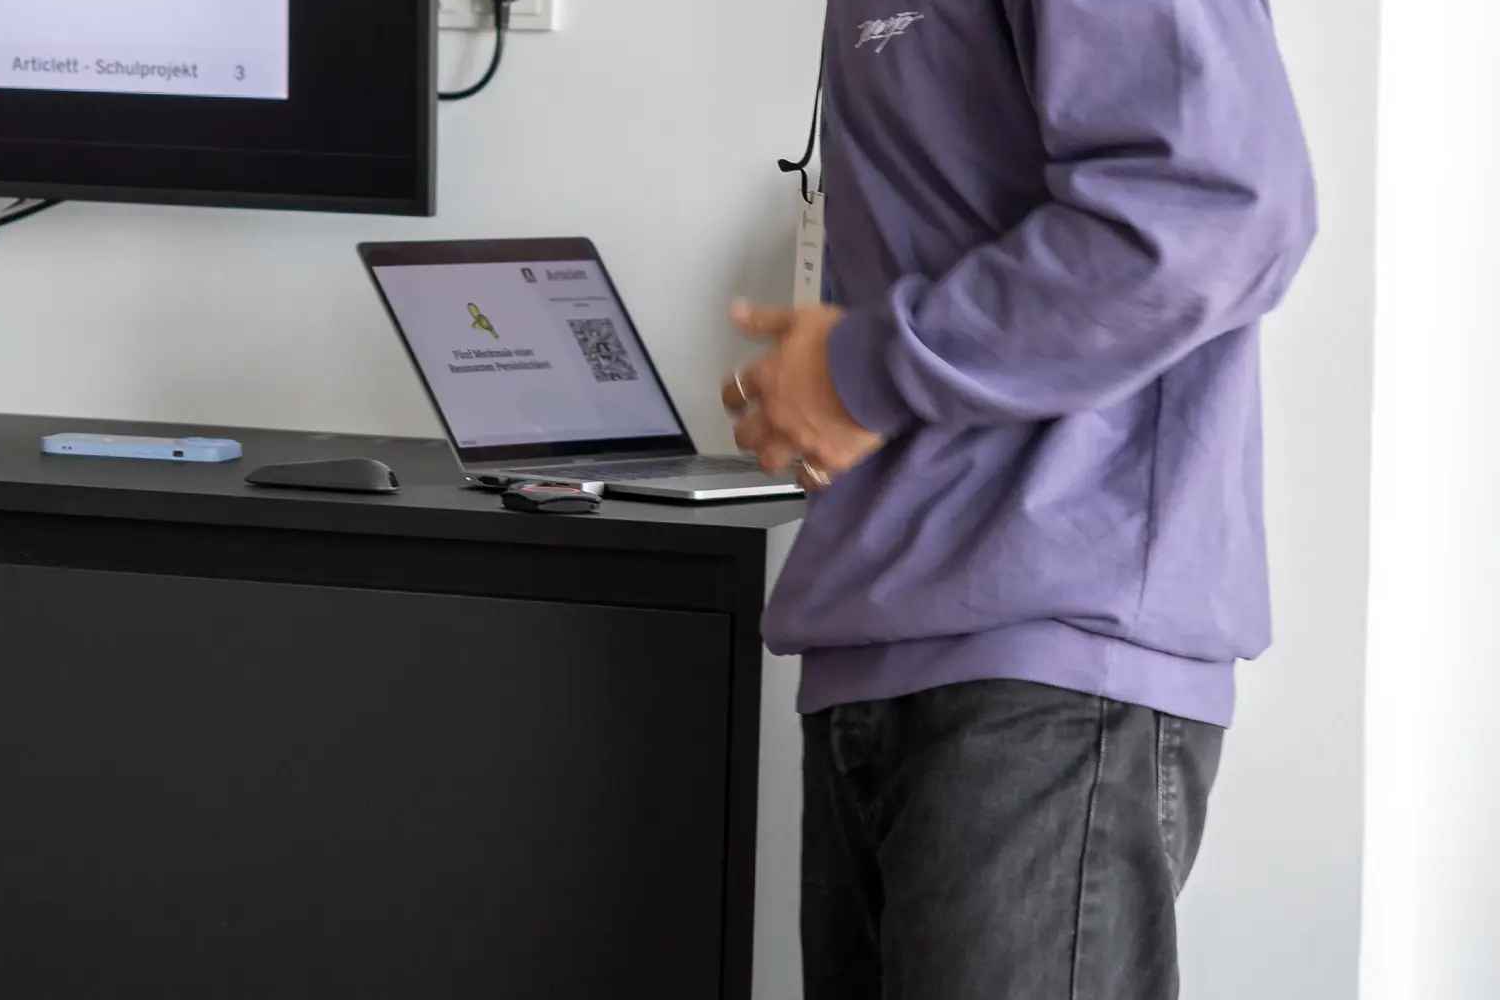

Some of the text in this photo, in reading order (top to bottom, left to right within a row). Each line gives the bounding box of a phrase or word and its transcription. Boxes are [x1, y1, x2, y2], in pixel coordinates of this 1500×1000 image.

[10, 55, 80, 75] Articlett
[94, 58, 199, 82] Schulprojekt
[234, 64, 247, 82] 3
